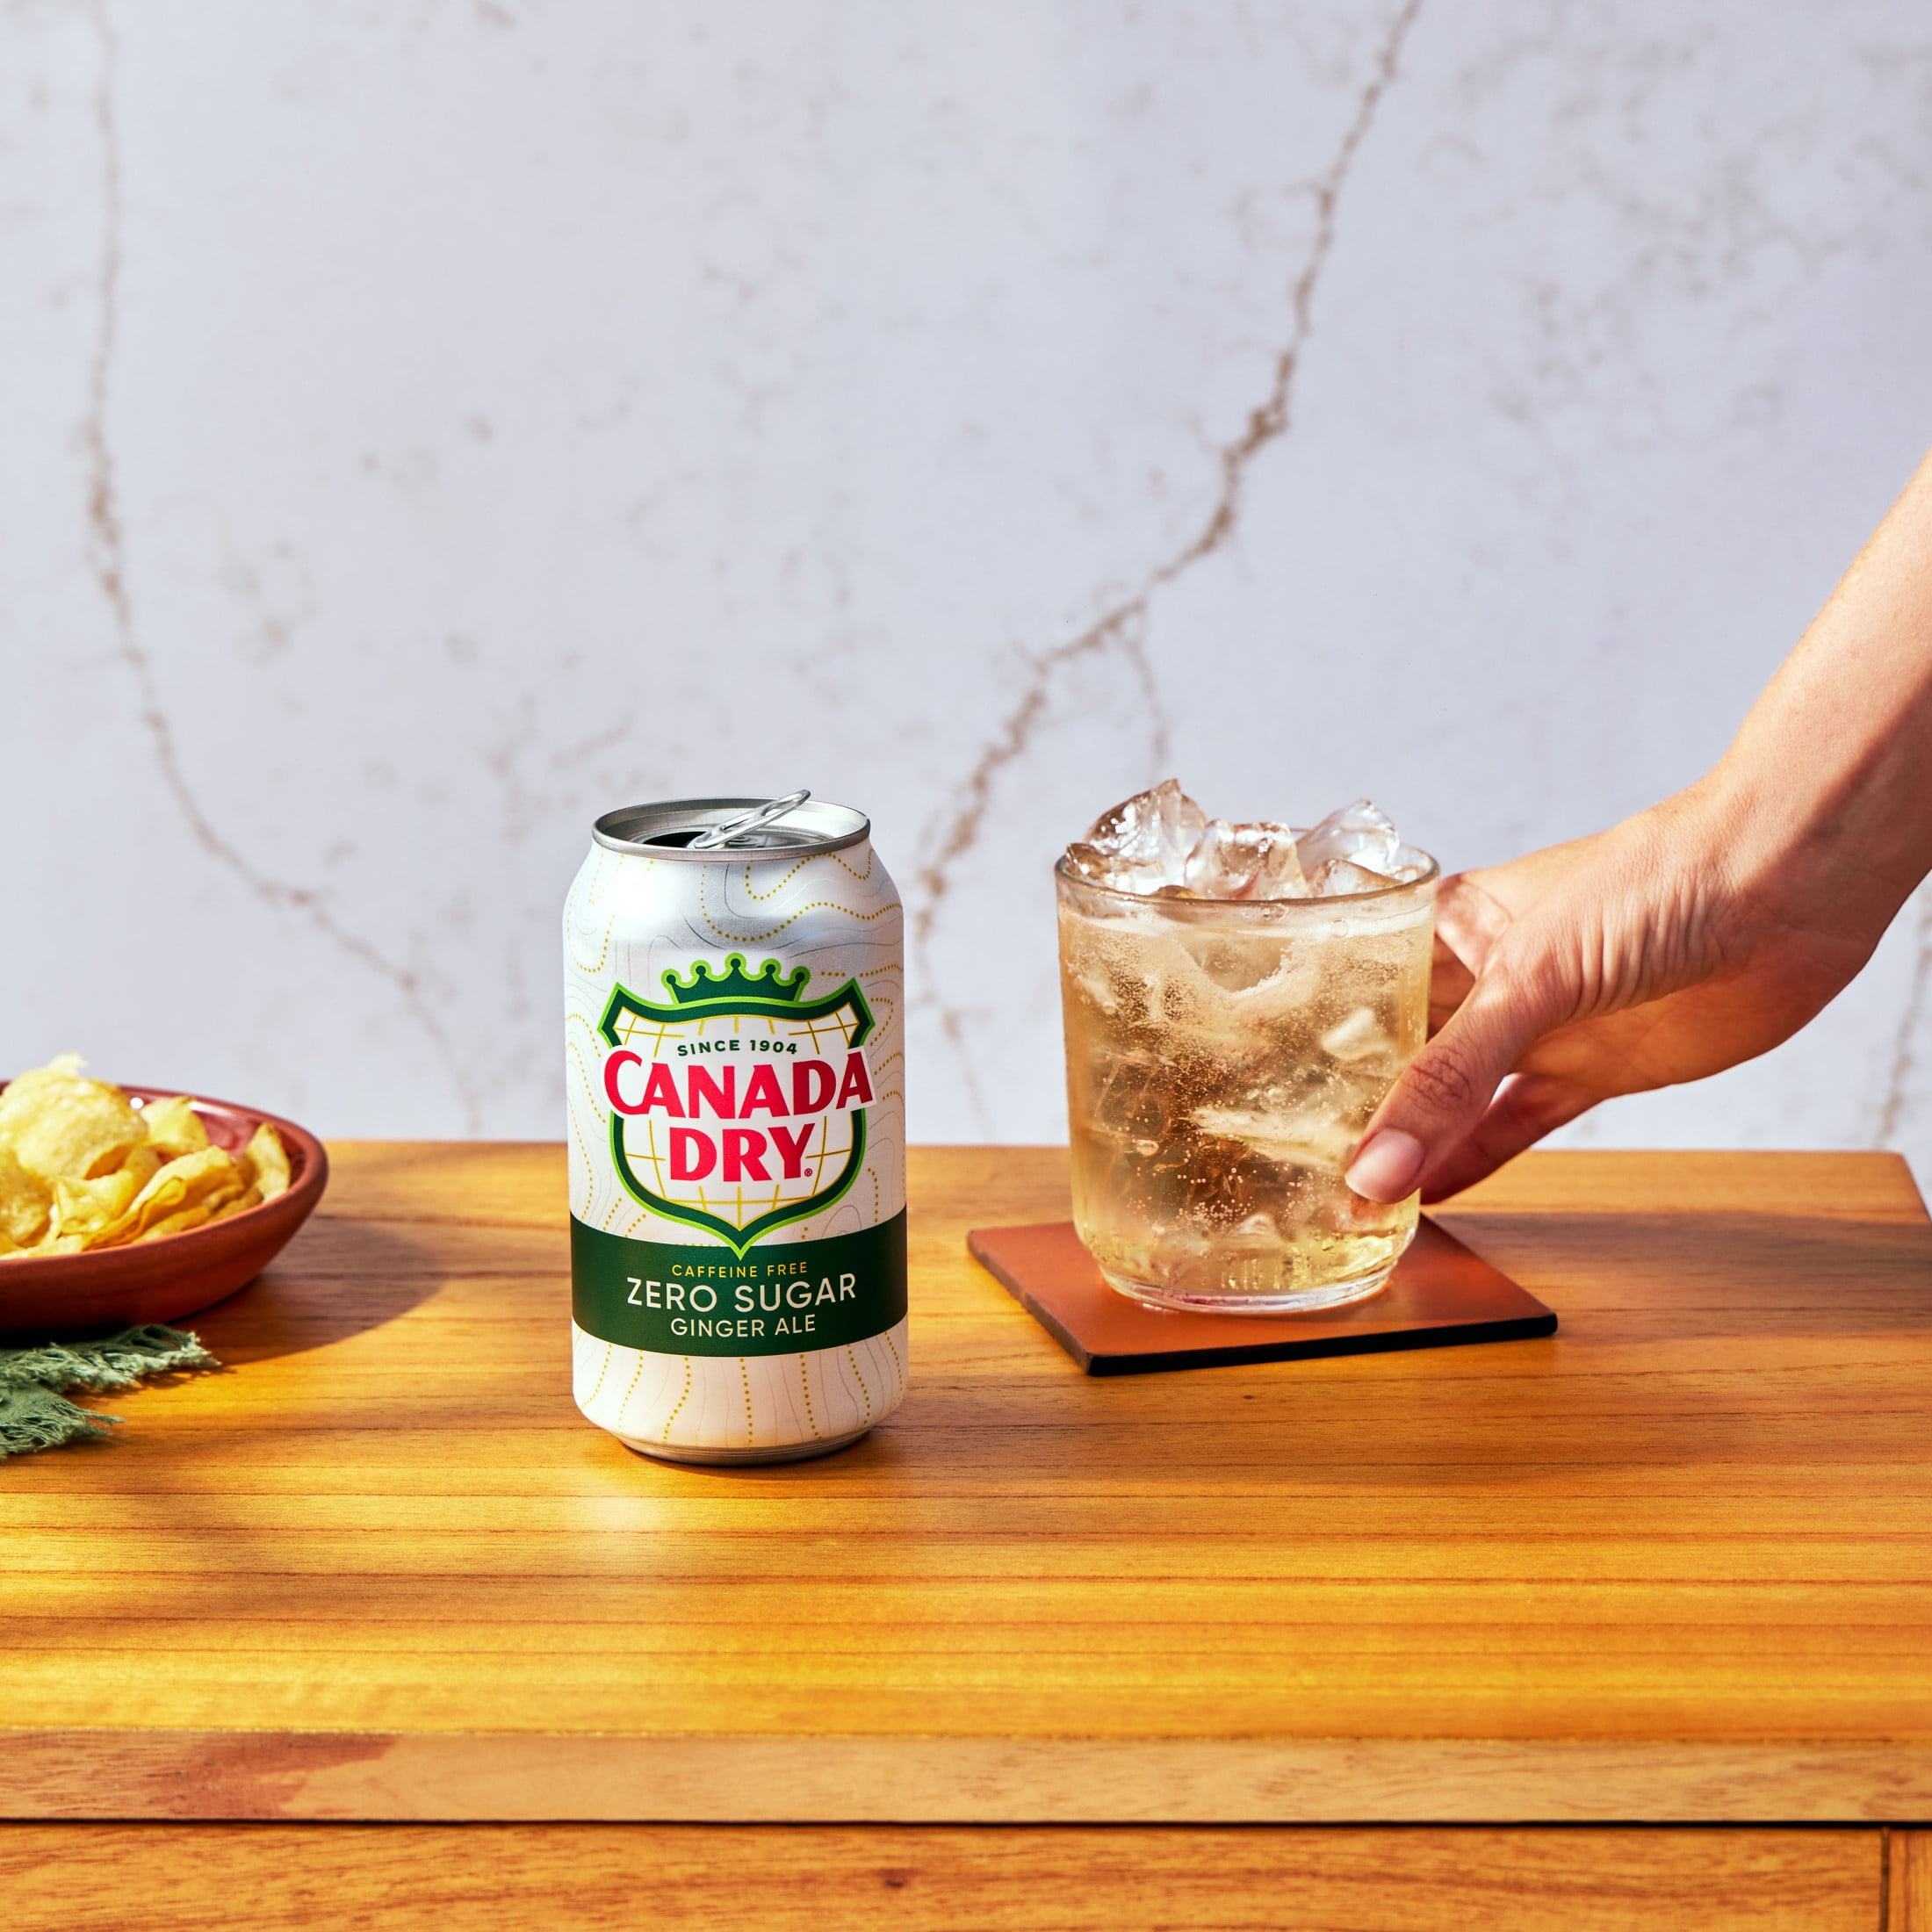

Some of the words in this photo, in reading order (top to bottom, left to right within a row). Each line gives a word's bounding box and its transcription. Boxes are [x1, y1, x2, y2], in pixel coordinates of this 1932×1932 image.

[677, 1039, 740, 1056] SINCE
[749, 1039, 797, 1055] 1904
[604, 1049, 873, 1120] CANADA
[672, 1264, 758, 1279] CAFFEINE
[767, 1261, 808, 1276] FREE
[626, 1277, 717, 1312] ZERO
[734, 1273, 857, 1312] SUGAR
[670, 1317, 766, 1337] GINGER
[775, 1314, 816, 1336] ALE
